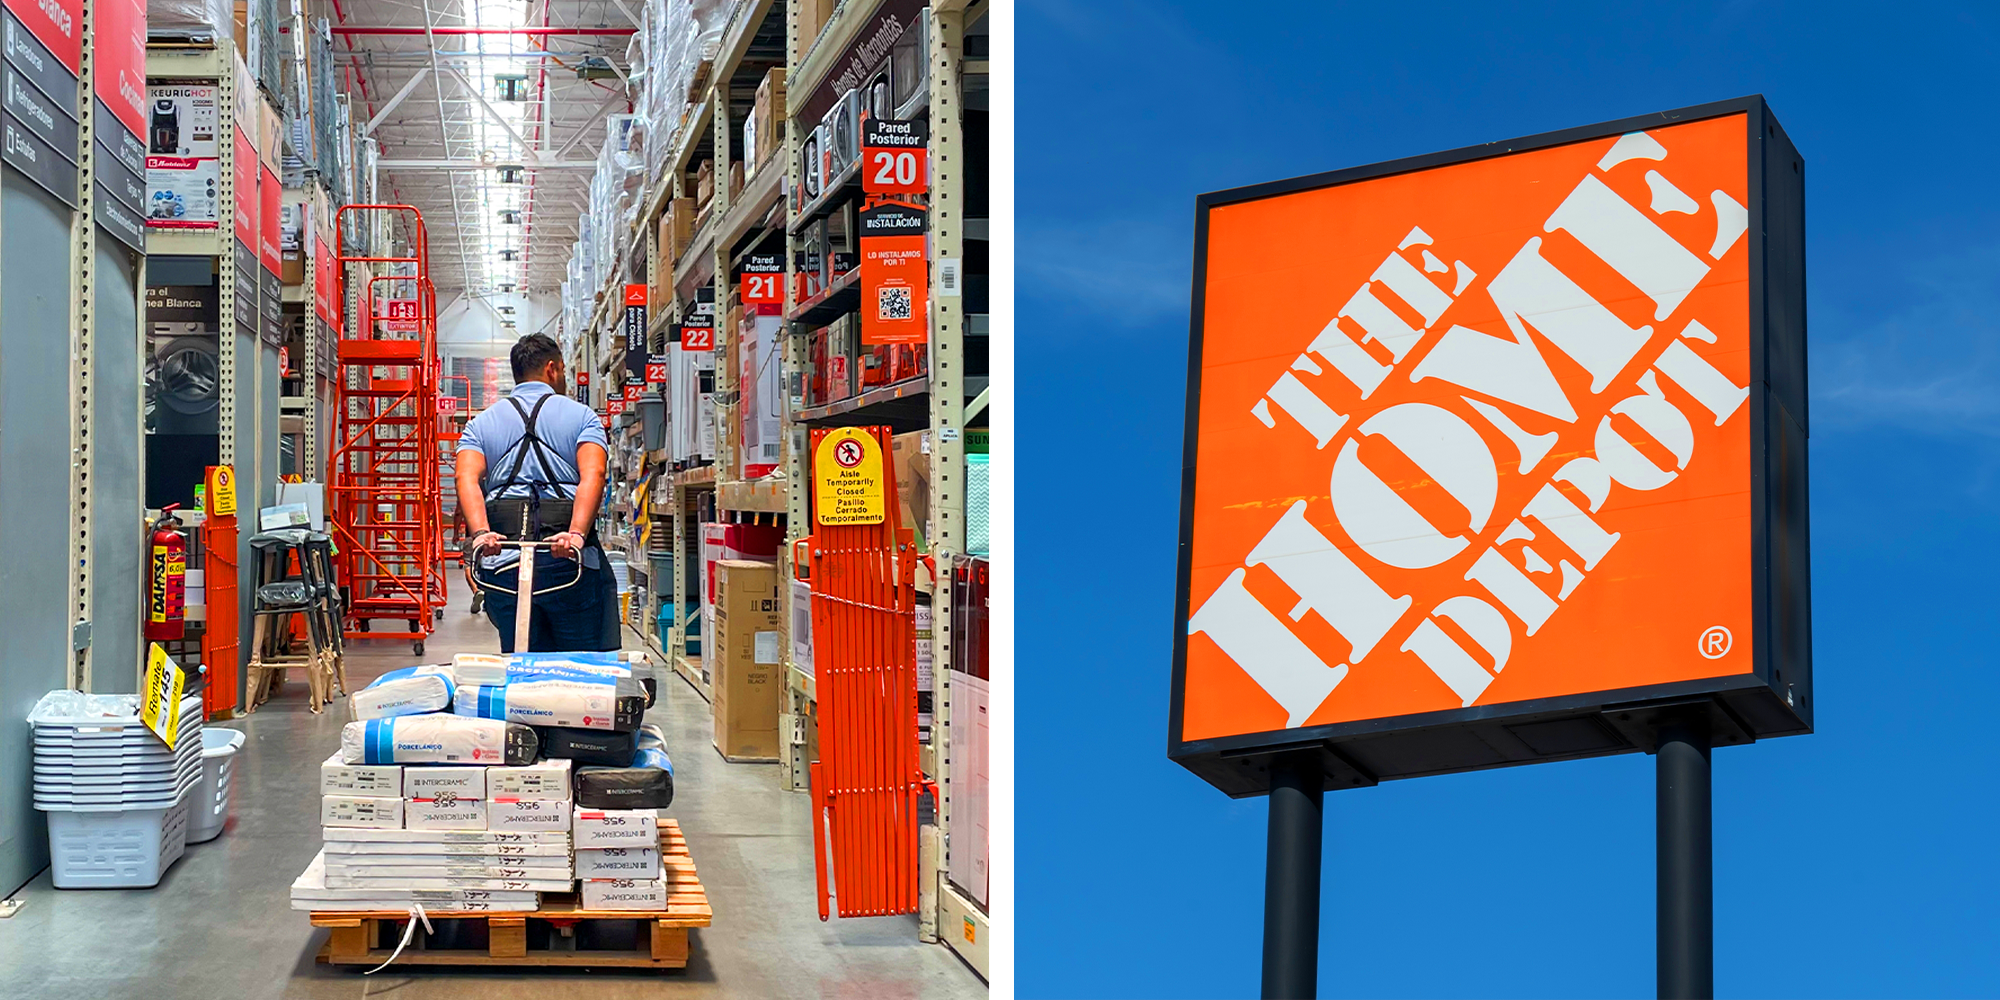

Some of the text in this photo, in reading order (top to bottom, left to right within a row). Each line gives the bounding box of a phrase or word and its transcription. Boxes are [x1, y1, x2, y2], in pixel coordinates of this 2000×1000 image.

[16, 32, 43, 72] Lavadoras
[831, 14, 904, 98] Hornos de Microondas
[119, 69, 145, 119] Cocinas
[16, 84, 54, 130] Refrigeradores
[878, 123, 911, 134] Pared
[870, 133, 920, 145] Posterior
[16, 133, 36, 162] Estufas
[873, 152, 917, 185] 20
[867, 216, 921, 228] INSTALACIÓN
[867, 250, 921, 259] LO INSTALAMOS
[752, 256, 774, 264] Pared
[883, 258, 898, 266] POR
[745, 264, 780, 272] Posterior
[159, 287, 168, 296] el
[748, 276, 774, 298] 21
[166, 299, 202, 308] Blanca
[628, 307, 636, 324] para
[636, 307, 644, 346] Accesorios
[686, 330, 709, 347] 22
[1251, 226, 1477, 450] THE
[649, 366, 667, 380] 23
[628, 387, 643, 399] 24
[610, 402, 623, 412] 25
[1187, 130, 1749, 729] HOME
[826, 478, 874, 487] Temporarily
[836, 488, 865, 496] Closed
[836, 506, 868, 514] Cerrado
[1400, 318, 1750, 708] DEPOT
[821, 514, 883, 523] Temporalmente
[149, 661, 163, 715] Remate
[160, 667, 171, 704] 145
[509, 707, 553, 716] PORCELÁNICO
[574, 743, 608, 752] INTERCERAMIC
[422, 778, 469, 786] INTERCERAMIC
[516, 801, 540, 810] 95S
[423, 813, 470, 822] INTERCERAMIC
[504, 815, 552, 824] INTERCERAMIC
[602, 817, 626, 826] 95S
[590, 830, 639, 839] INTERCERAMIC
[603, 848, 628, 856] 95S
[592, 862, 640, 870] INTERCERAMIC
[612, 880, 635, 888] 95S
[600, 894, 648, 902] INTERCERAMIC
